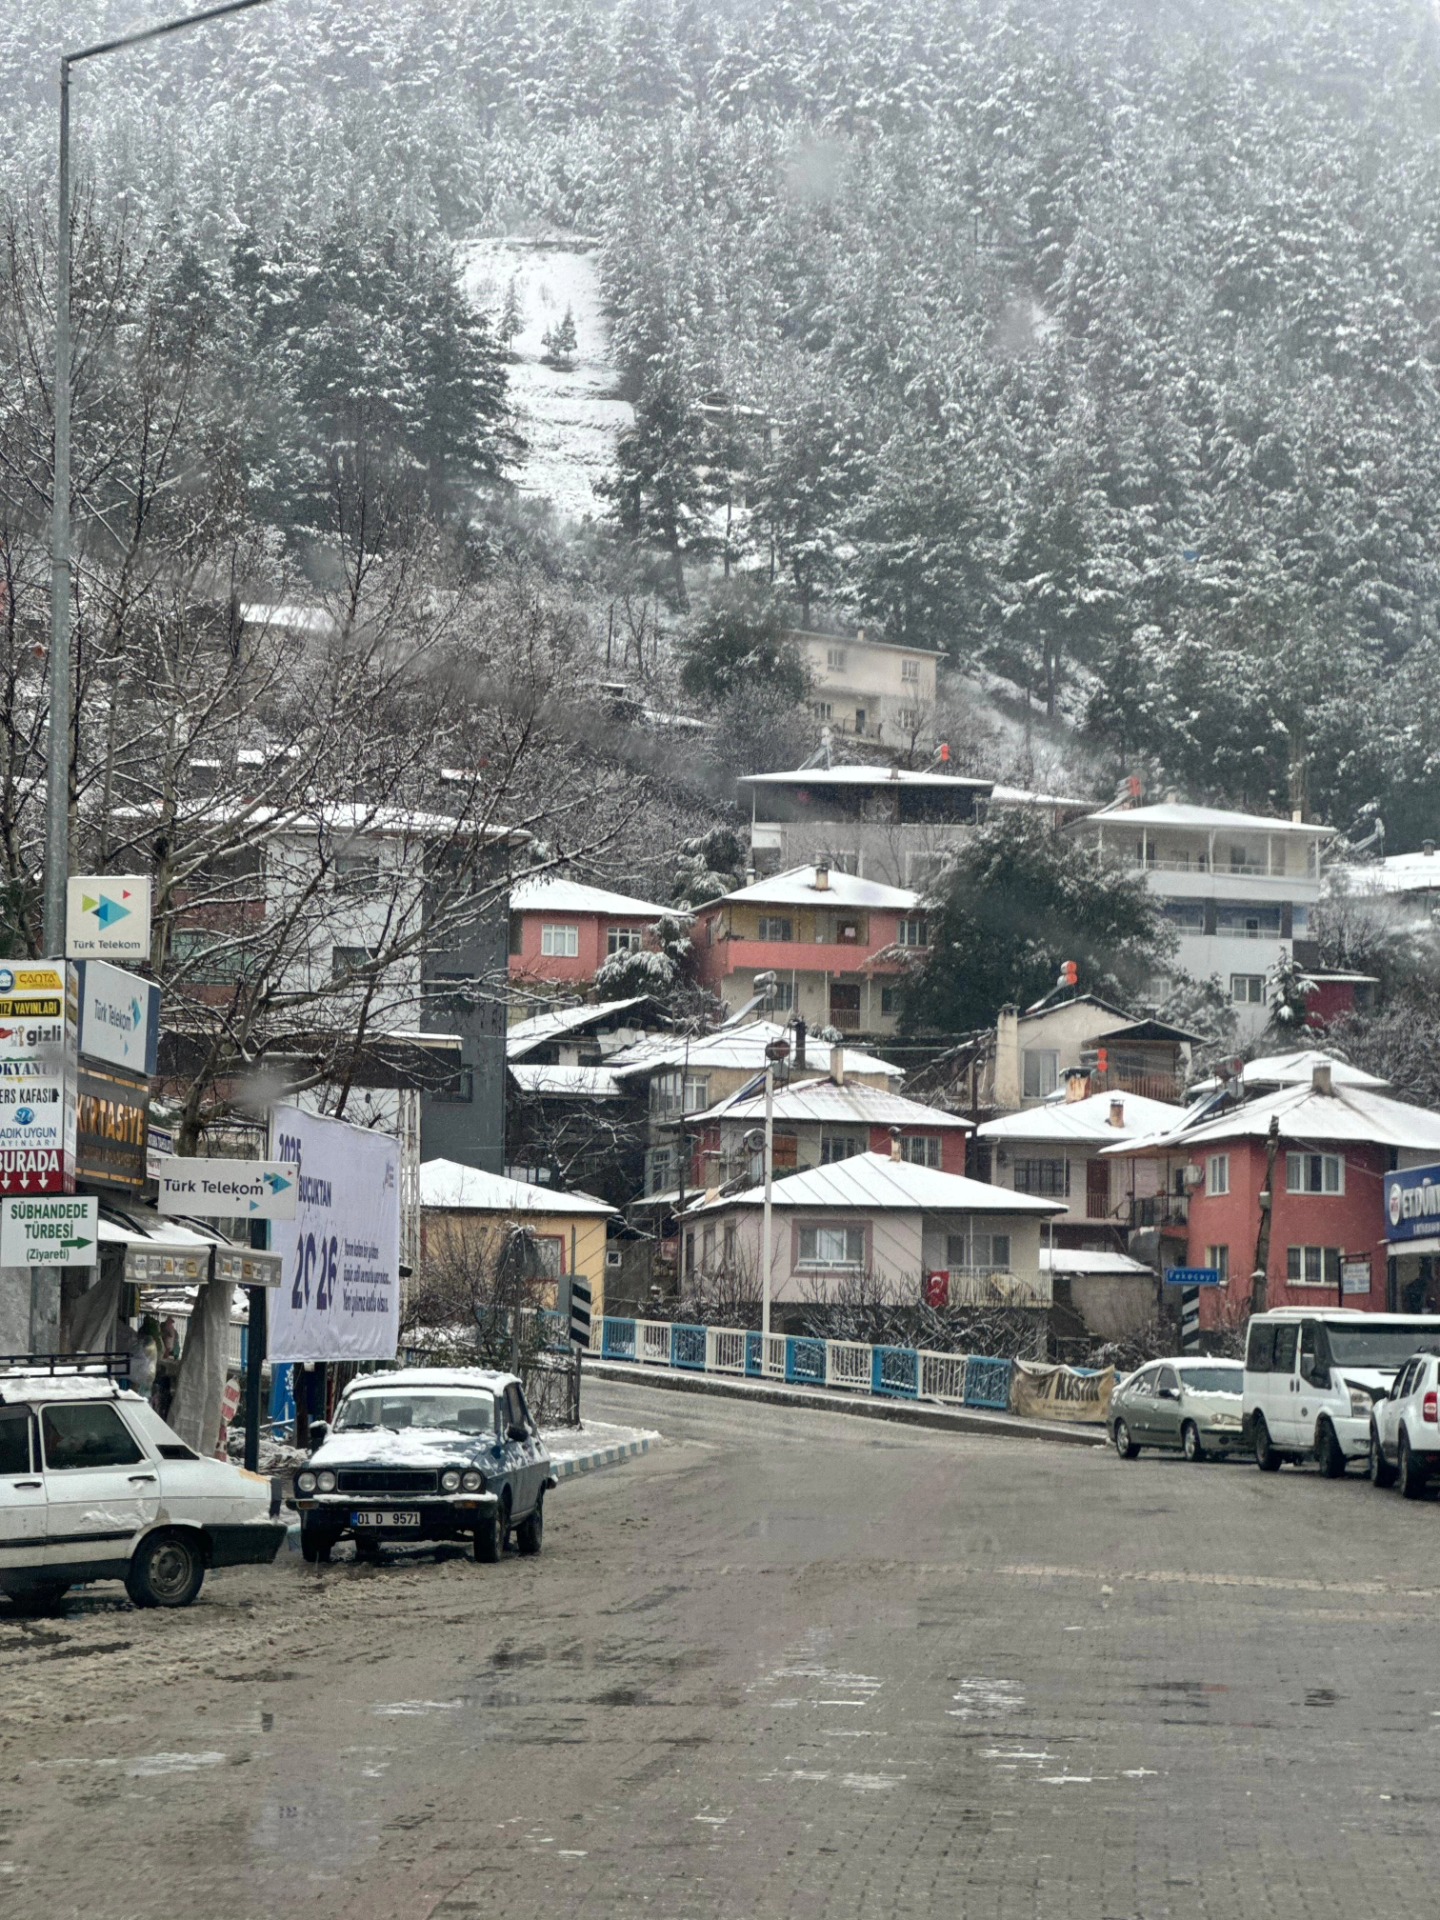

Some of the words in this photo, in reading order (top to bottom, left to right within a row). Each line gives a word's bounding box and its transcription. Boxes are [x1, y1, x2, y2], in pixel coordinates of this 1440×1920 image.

[73, 940, 95, 949] Türk
[98, 940, 141, 949] Telekom
[14, 1001, 57, 1014] YAYINLARI
[94, 999, 107, 1022] Türk
[108, 1005, 132, 1031] Telekom
[26, 1025, 62, 1046] gizli
[24, 1127, 57, 1138] UYGUN
[163, 1179, 196, 1192] Türk
[201, 1180, 264, 1195] Telekom
[11, 1201, 88, 1219] SÜBHANDEDE
[25, 1220, 73, 1239] TÜRBESİ
[26, 1248, 70, 1262] (Ziyareti)
[291, 1232, 338, 1310] 2026
[358, 1513, 370, 1524] 01
[376, 1513, 383, 1524] D
[393, 1513, 419, 1524] 9571
